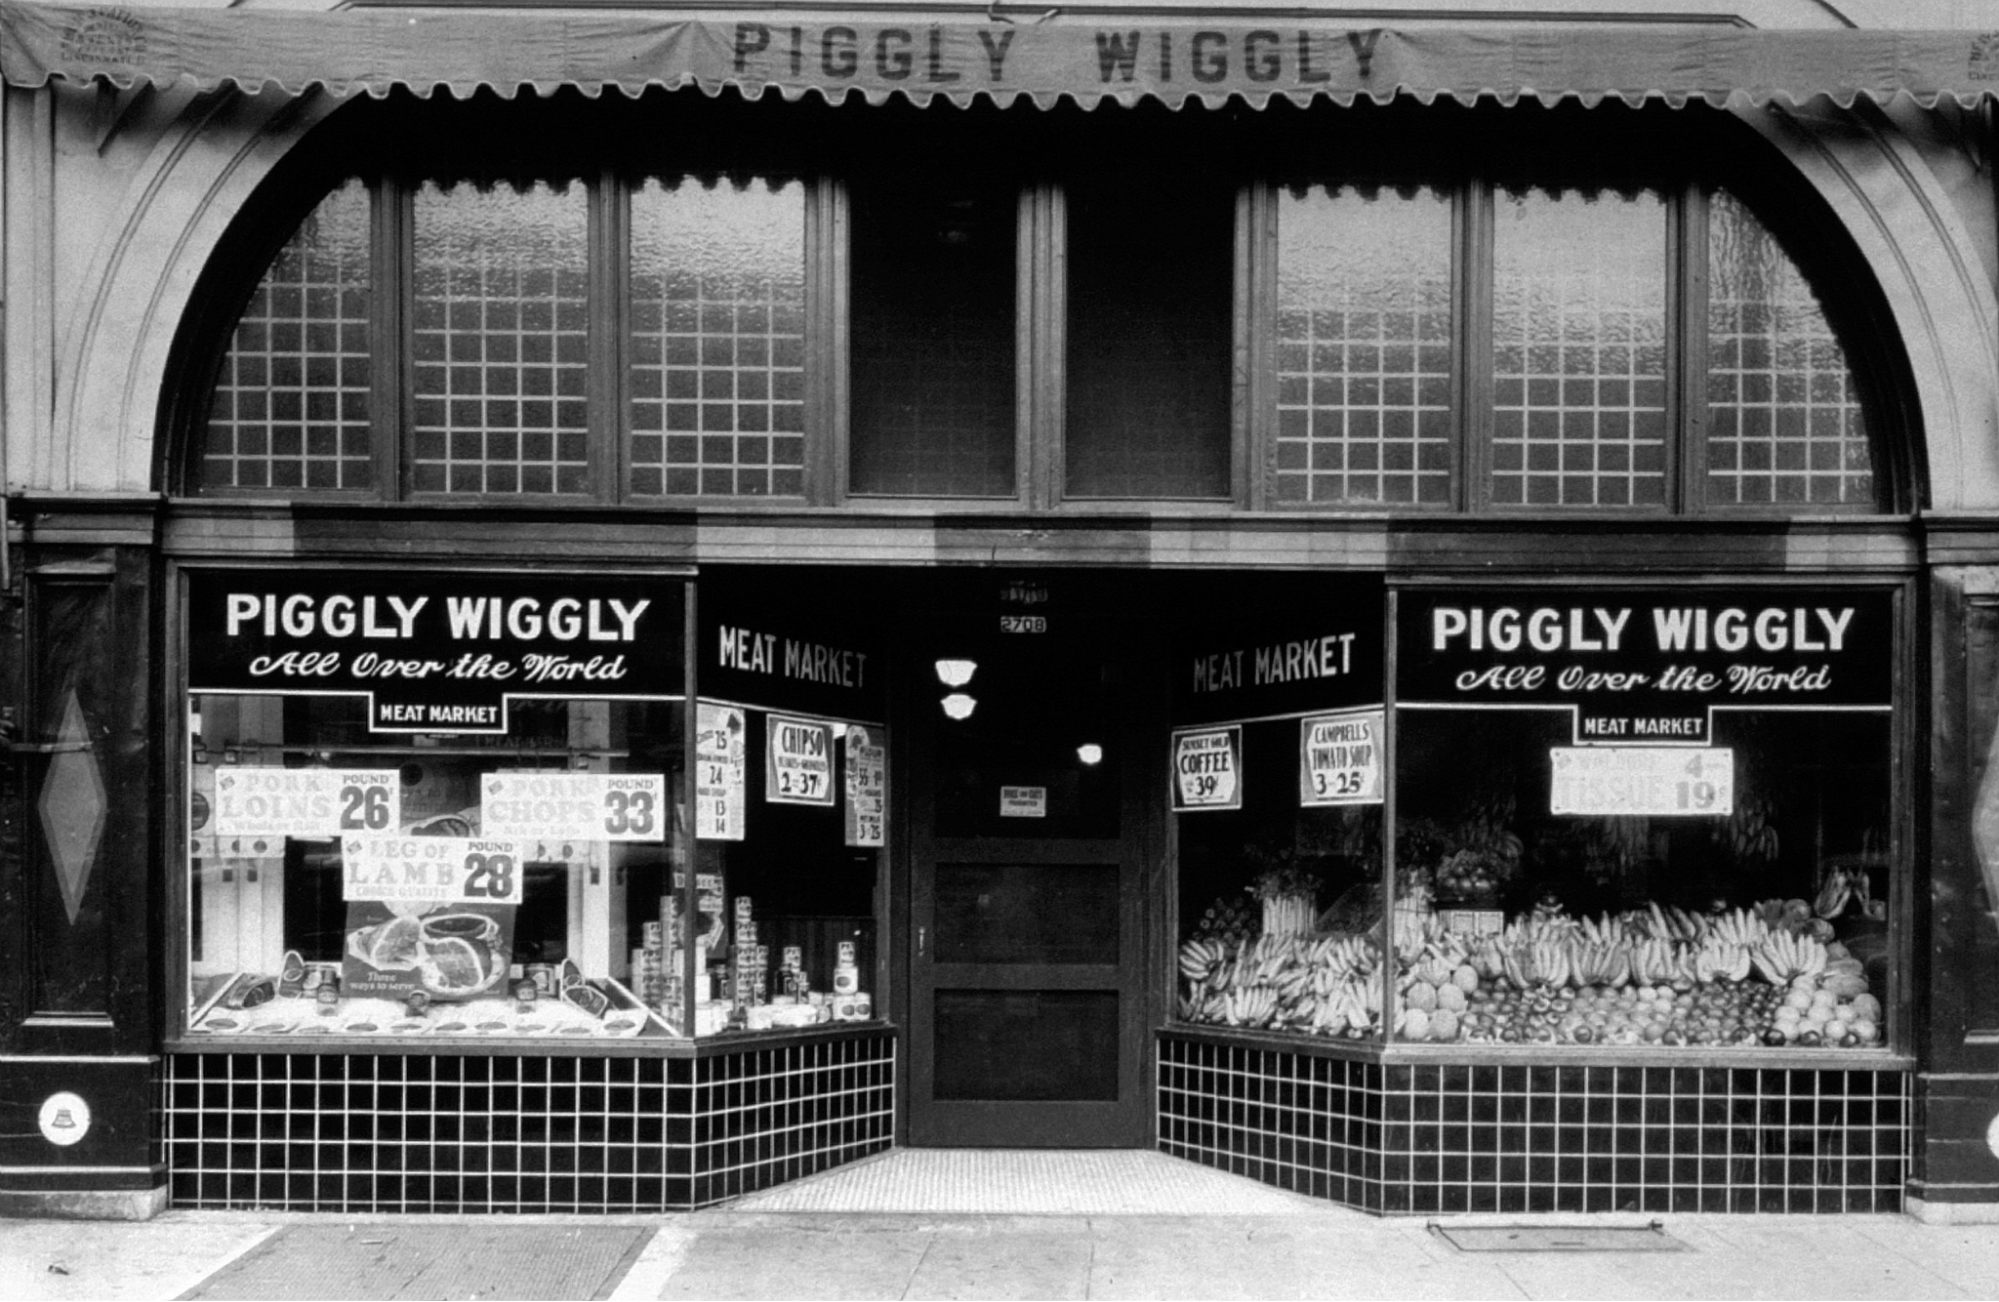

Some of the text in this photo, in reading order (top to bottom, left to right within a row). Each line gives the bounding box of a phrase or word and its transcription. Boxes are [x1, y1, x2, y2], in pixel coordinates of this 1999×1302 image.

[734, 22, 1381, 84] PIGGLY WIGGLY
[226, 593, 651, 642] PIGGLY WIGGLY
[1001, 618, 1045, 632] 2708
[1433, 607, 1855, 652] PIGGLY WIGGLY
[719, 624, 867, 686] MEAT MARKET
[1193, 632, 1355, 693] MEAT MARKET
[249, 651, 628, 683] All Over the World
[1456, 664, 1832, 694] All Over the World
[381, 705, 498, 724] MEAT MARKET
[1315, 723, 1369, 744] CAMPBELLS
[1585, 717, 1703, 736] MEAT MARKET
[782, 726, 824, 757] CHIPSO
[1180, 751, 1230, 775] COFFEE
[1312, 745, 1372, 770] TOMATO SOUP
[1685, 754, 1703, 778] 4
[245, 774, 323, 792] PORK
[343, 774, 389, 785] POUND
[608, 779, 654, 789] POUND
[710, 765, 722, 784] 24
[511, 779, 589, 797] PORK
[222, 795, 332, 819] LOINS
[488, 800, 597, 823] CHOPS
[369, 841, 449, 858] LEG OF
[468, 841, 514, 852] POUND
[349, 862, 455, 885] LAMB
